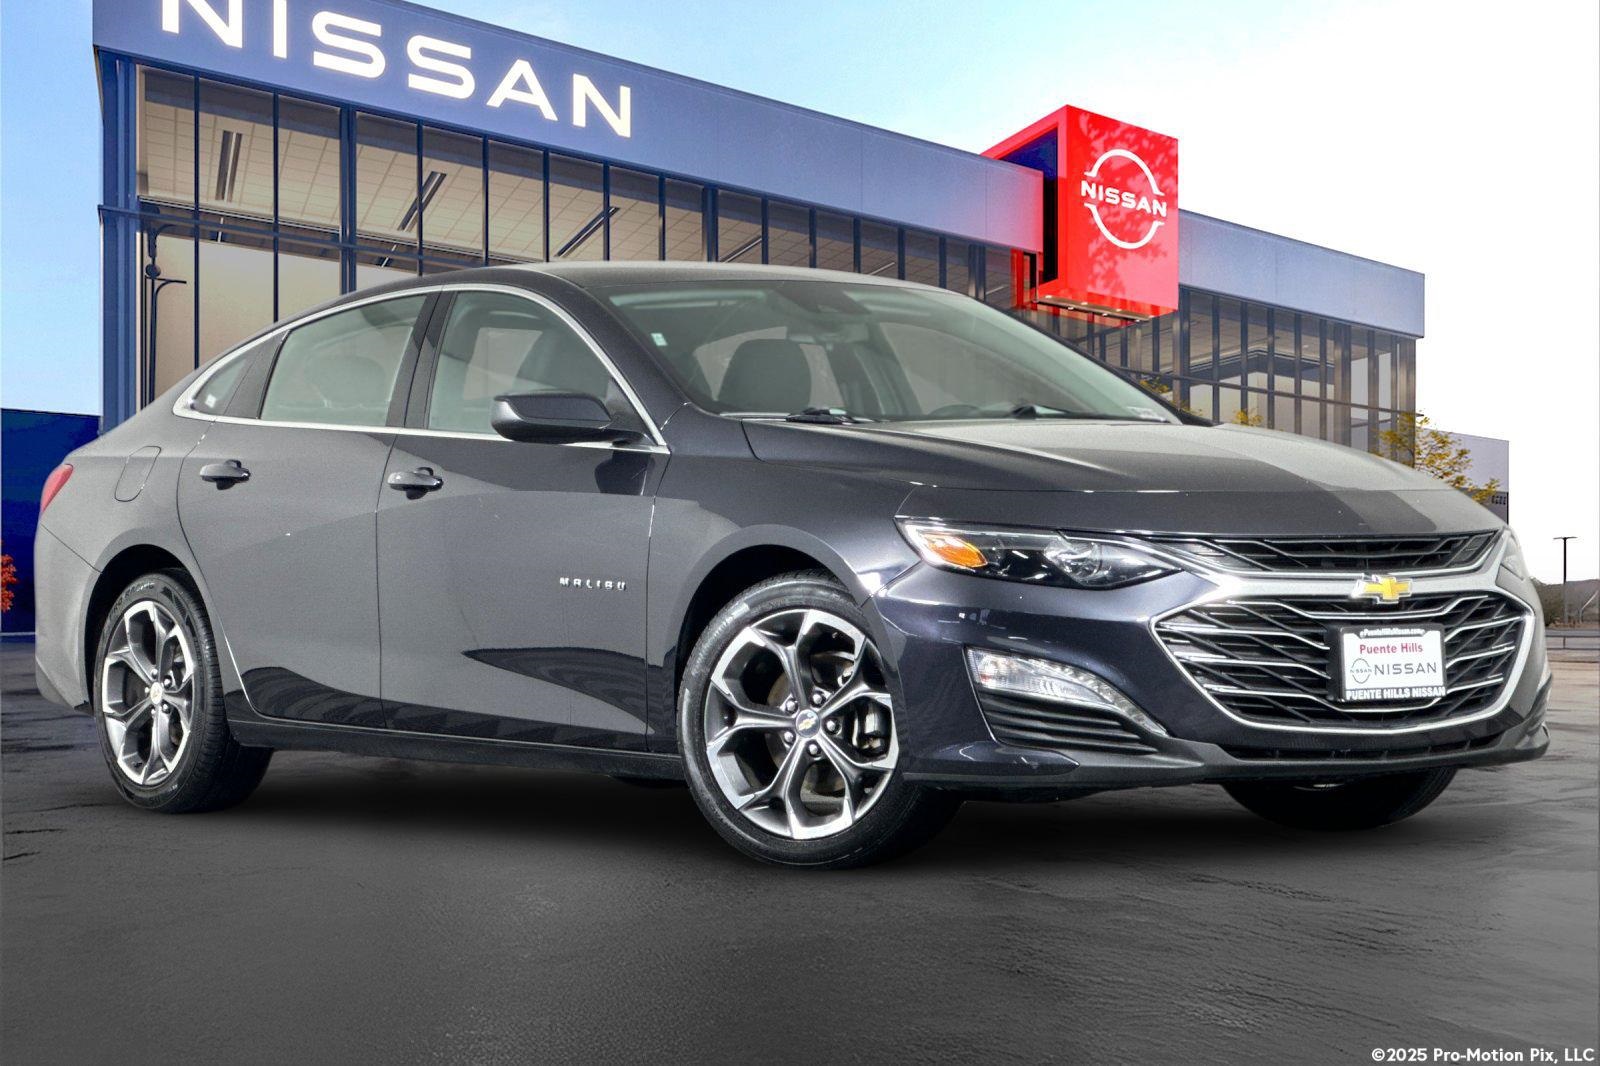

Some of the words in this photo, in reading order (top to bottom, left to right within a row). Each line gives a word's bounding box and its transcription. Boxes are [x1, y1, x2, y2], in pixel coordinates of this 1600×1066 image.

[162, 0, 632, 138] NISSAN
[1081, 180, 1167, 217] NISSAN
[560, 577, 626, 591] MALIBU
[1360, 644, 1397, 654] Puente
[1401, 643, 1423, 653] Hills
[1374, 662, 1437, 676] NISSAN
[1346, 689, 1382, 700] PUENTE
[1383, 688, 1410, 699] HILLS
[1412, 686, 1446, 697] NISSAN
